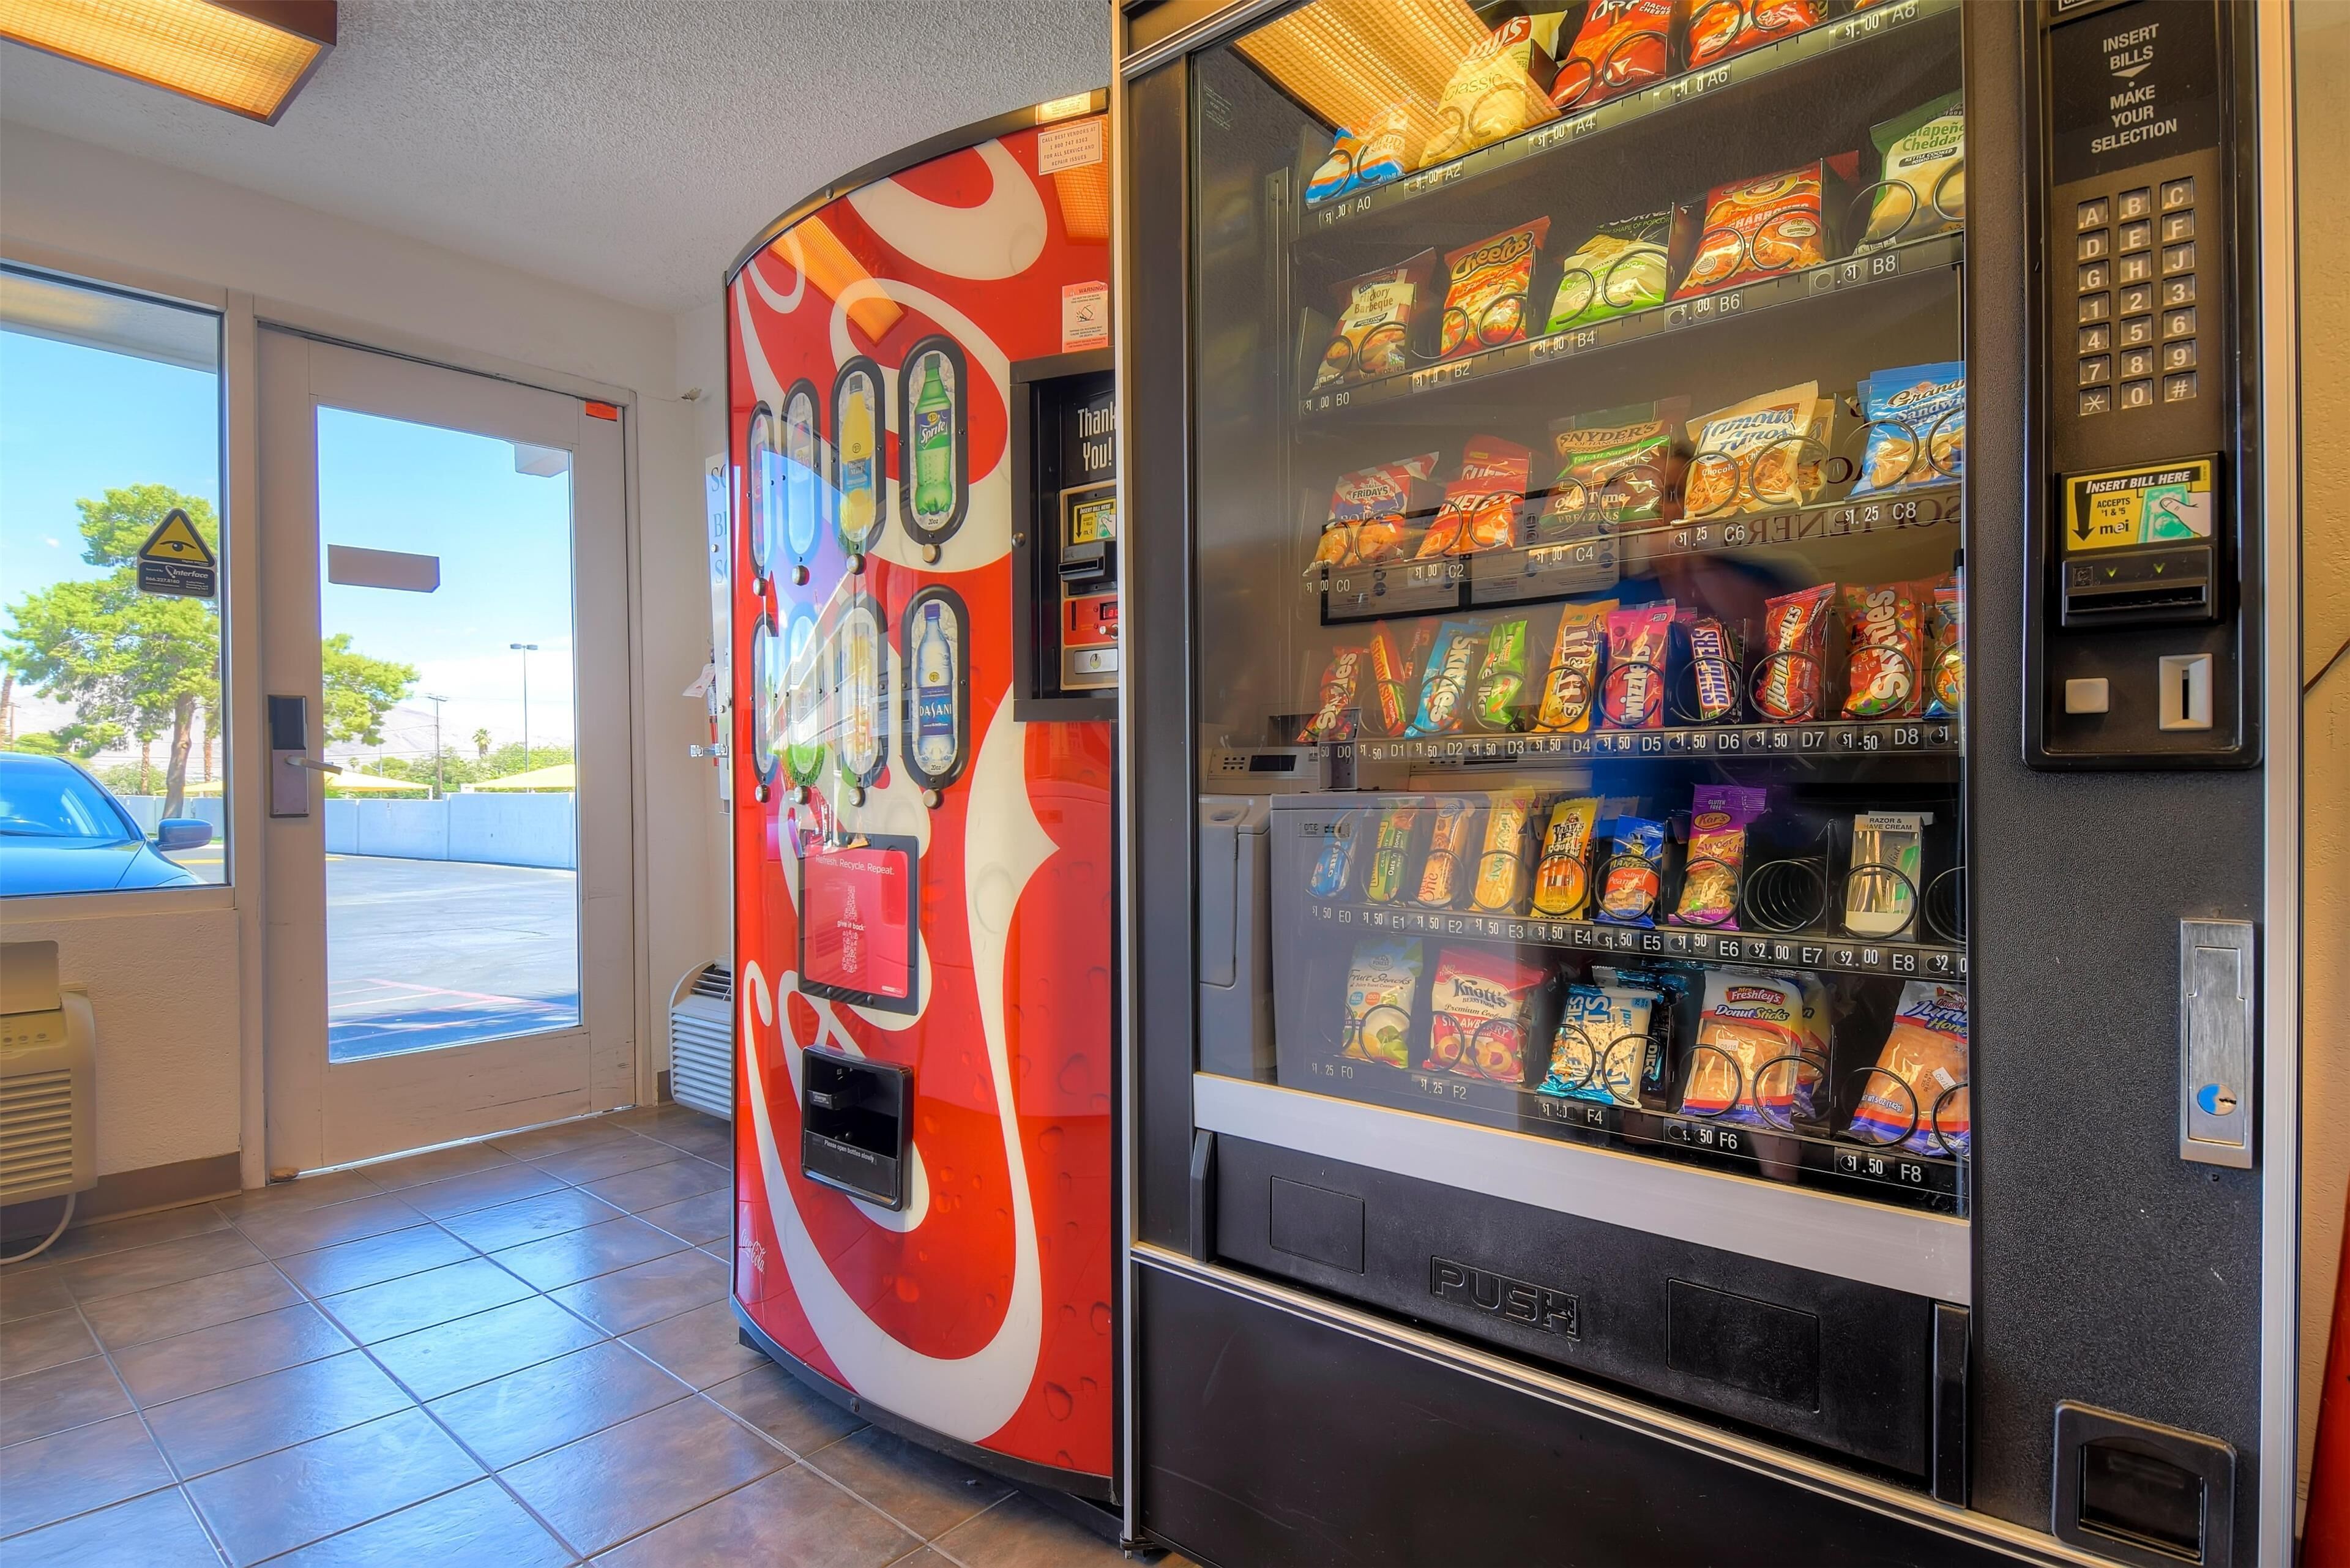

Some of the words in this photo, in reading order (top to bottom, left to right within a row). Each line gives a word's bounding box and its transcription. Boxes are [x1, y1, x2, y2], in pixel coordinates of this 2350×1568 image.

[1846, 14, 1879, 38] $1.00
[1892, 5, 1916, 23] A8
[2103, 23, 2159, 53] INSERT
[2110, 45, 2154, 70] BILLS
[1707, 69, 1727, 87] A6
[2109, 84, 2155, 110] MAKE
[2111, 105, 2154, 128] YOUR
[1067, 128, 1089, 137] VENDORS
[1576, 118, 1595, 134] A4
[1902, 135, 1962, 152] Cheddar
[2091, 118, 2177, 154] SELECTION
[1064, 146, 1083, 155] SERVICE
[1904, 152, 1926, 163] KETTLE
[1927, 148, 1953, 159] COOKED
[1445, 166, 1460, 180] A2
[1357, 196, 1370, 212] A0
[2170, 187, 2184, 205] C
[2128, 197, 2141, 215] B
[1643, 217, 1671, 226] POPCOR
[2085, 207, 2098, 226] A
[2171, 220, 2184, 237] F
[2129, 229, 2141, 247] E
[1452, 231, 1534, 281] Cheetos
[2087, 239, 2100, 256] D
[1873, 255, 1895, 275] B8
[2129, 260, 2143, 278] H
[2172, 251, 2184, 269] J
[2087, 269, 2100, 287] G
[2130, 293, 2143, 310] 2
[2173, 284, 2185, 302] 3
[1354, 297, 1393, 314] Barbeque
[1720, 294, 1740, 312] B6
[2091, 301, 2099, 318] 1
[2130, 324, 2143, 342] 5
[2173, 315, 2185, 334] 6
[1578, 330, 1595, 348] B4
[2088, 331, 2100, 349] 4
[2131, 356, 2143, 373] 8
[2173, 348, 2187, 366] 9
[1455, 363, 1470, 378] B2
[2089, 363, 2101, 381] 7
[1337, 392, 1349, 406] B0
[2131, 388, 2143, 405] 0
[920, 420, 946, 444] Sprite
[1561, 422, 1657, 447] SNYDER'S
[1083, 437, 1112, 471] You!
[2086, 479, 2128, 494] INSERT
[2130, 476, 2155, 488] BILL
[2158, 471, 2190, 483] HERE
[2097, 497, 2130, 509] ACCEPTS
[1845, 506, 1879, 525] $1.25
[1892, 502, 1916, 520] C8
[1679, 526, 1707, 546] $1.25
[1725, 525, 1745, 542] C6
[2100, 519, 2130, 535] mei
[1576, 546, 1594, 562] C4
[173, 569, 208, 578] Interface
[1416, 563, 1438, 582] $1.00
[1449, 564, 1464, 579] C2
[1337, 579, 1350, 592] C0
[1865, 589, 1911, 699] Skittles
[919, 703, 952, 719] DASANI
[1536, 738, 1561, 753] $1.50
[1573, 739, 1591, 752] D4
[1604, 736, 1630, 752] $1.50
[1642, 737, 1661, 751] D5
[1677, 732, 1706, 750] $1.50
[1718, 734, 1739, 749] D6
[1756, 731, 1788, 749] $1.50
[1802, 732, 1824, 747] D7
[1843, 733, 1878, 750] $1.50
[1894, 728, 1919, 745] D8
[1338, 746, 1351, 758] D0
[1360, 744, 1382, 760] $1.50
[1391, 744, 1404, 756] D1
[1416, 742, 1437, 758] $1.50
[1447, 742, 1463, 755] D2
[1472, 742, 1496, 756] $1.50
[1508, 741, 1524, 753] D3
[1698, 814, 1728, 825] Kar's
[816, 854, 838, 867] Refresh.
[840, 859, 865, 870] Recycle.
[867, 863, 895, 875] Repeat.
[1313, 906, 1331, 920] $1.50
[1339, 911, 1351, 922] E0
[1363, 912, 1383, 926] $1.50
[1393, 917, 1404, 928] E1
[1417, 916, 1439, 931] $1.50
[1449, 920, 1463, 933] E2
[1475, 919, 1498, 936] $1.50
[1509, 925, 1524, 938] E3
[1539, 927, 1563, 941] $1.50
[1575, 930, 1591, 944] E4
[1605, 933, 1632, 949] $1.50
[1644, 936, 1661, 950] E5
[1678, 934, 1707, 953] $1.50
[1720, 941, 1739, 956] E6
[1755, 943, 1789, 960] $2.00
[1802, 947, 1822, 963] E7
[1841, 949, 1878, 967] $2.00
[1893, 954, 1915, 971] E8
[1372, 973, 1412, 985] Snacks
[1453, 979, 1507, 1008] Knott's
[1731, 988, 1781, 1004] Freshley's
[1444, 1004, 1480, 1014] Premium
[1715, 1005, 1755, 1018] Donut
[1755, 1009, 1790, 1021] Sticks
[1312, 1063, 1334, 1077] $1.25
[1341, 1066, 1352, 1078] F0
[1420, 1078, 1442, 1095] $1.25
[1453, 1087, 1466, 1100] F2
[1587, 1108, 1603, 1124] F4
[1720, 1132, 1737, 1149] F6
[824, 1140, 837, 1149] Please
[847, 1147, 860, 1157] bottles
[861, 1152, 874, 1163] slowly
[1848, 1155, 1883, 1174] $1.50
[1901, 1164, 1922, 1182] F8
[1436, 1261, 1576, 1335] PUSH
